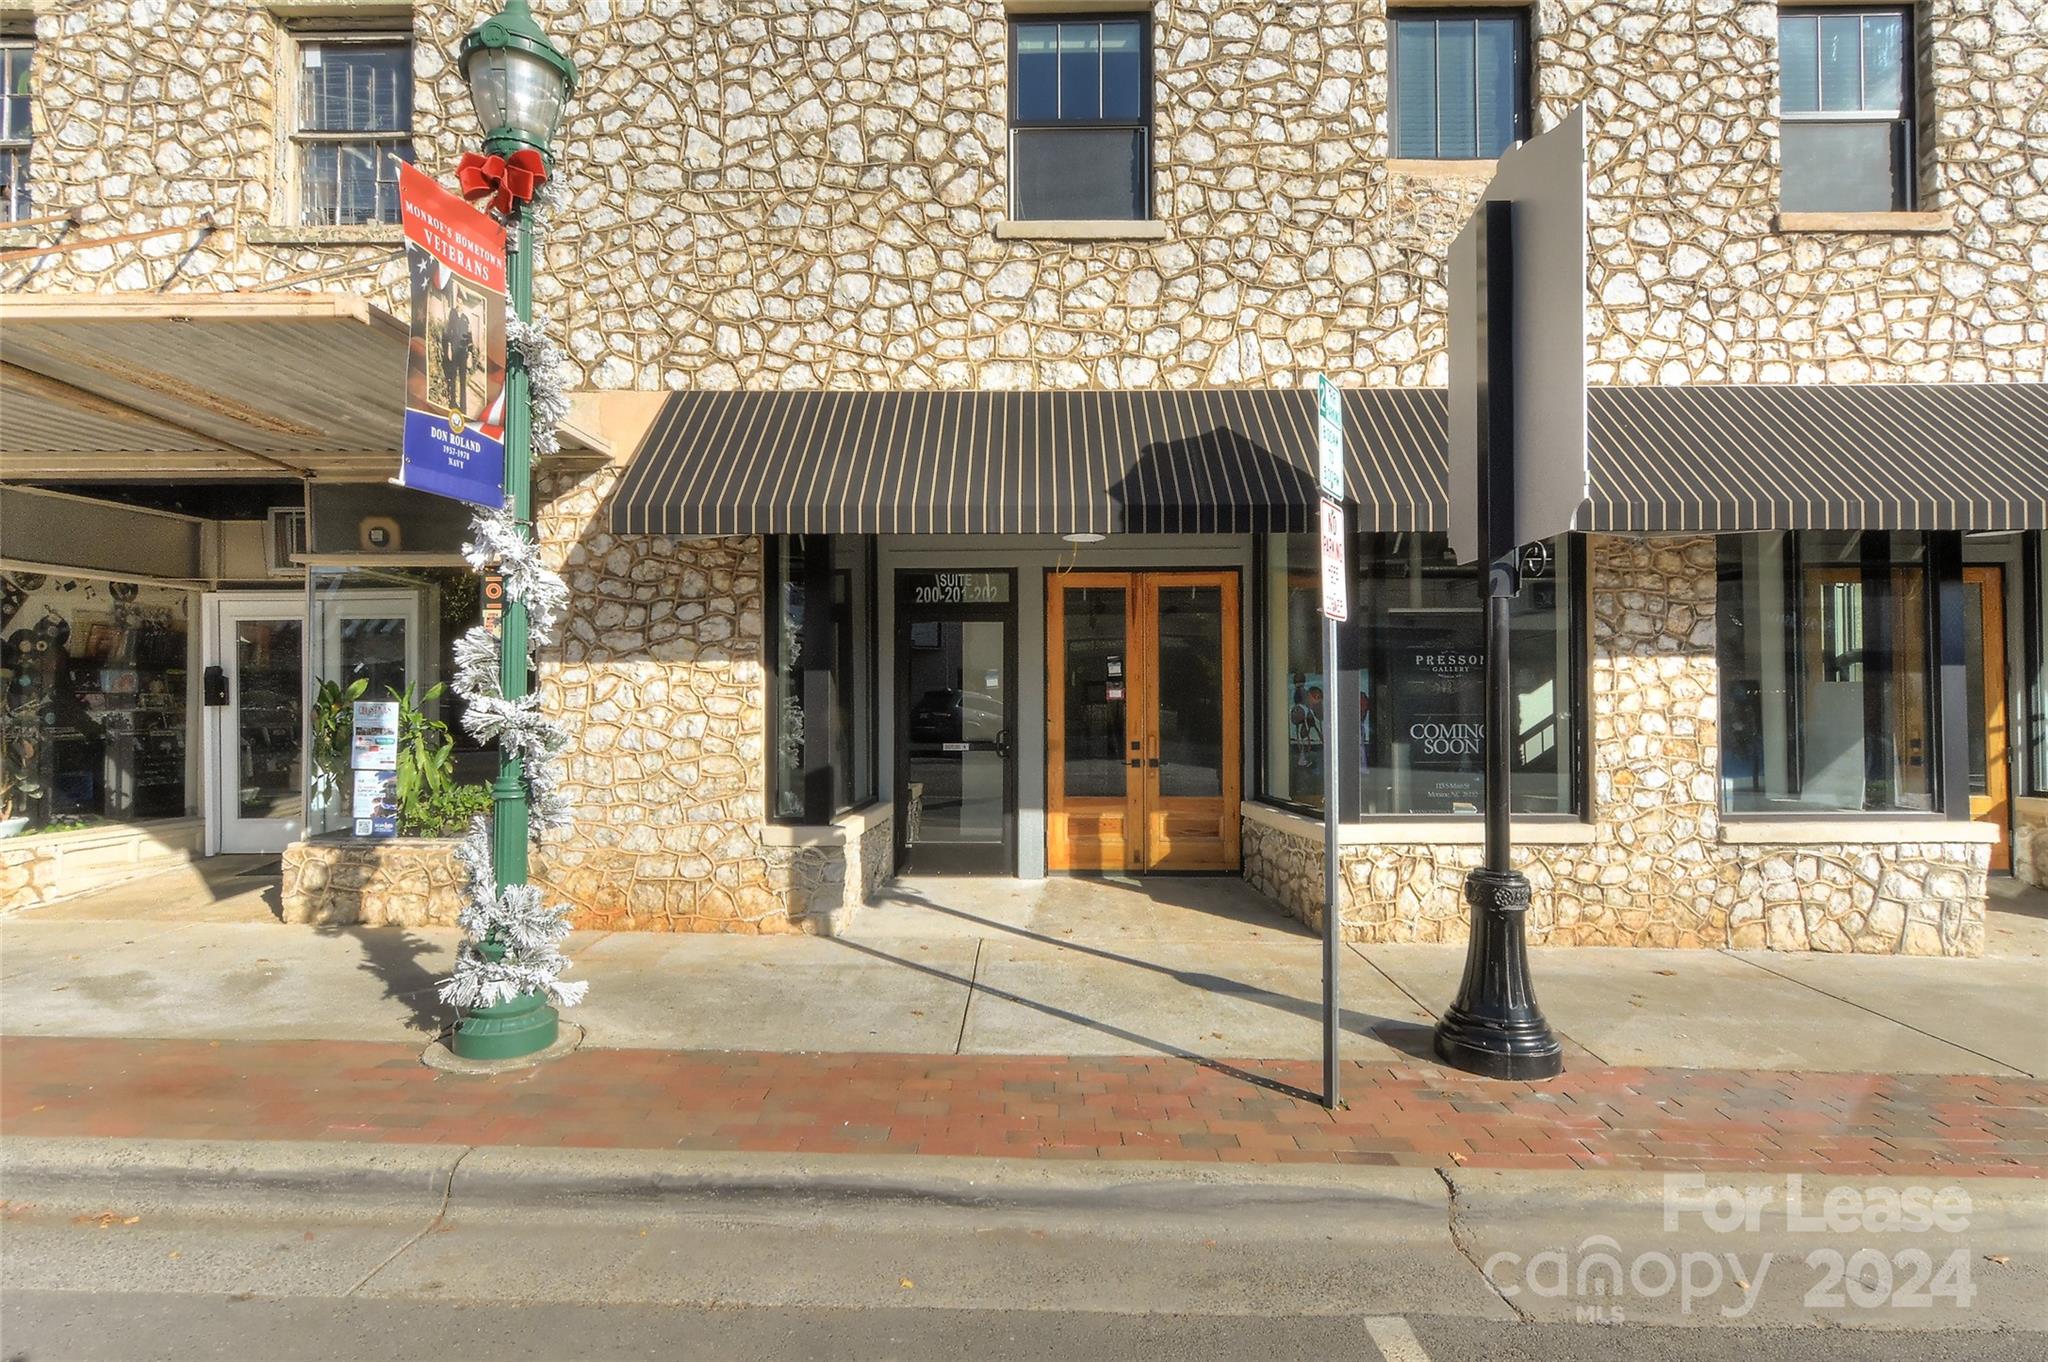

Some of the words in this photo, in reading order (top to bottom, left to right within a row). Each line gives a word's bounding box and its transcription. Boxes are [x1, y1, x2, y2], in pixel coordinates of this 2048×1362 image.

[405, 200, 453, 239] MONROE'S
[455, 231, 502, 270] HOMETOWN
[423, 228, 490, 281] VETERANS
[1320, 383, 1327, 412] 2
[431, 426, 448, 442] DON
[450, 433, 481, 453] ROLAND
[448, 457, 464, 469] NAVY
[940, 573, 972, 587] SUITE
[915, 586, 998, 603] 200-201-202
[1424, 738, 1480, 754] SOON
